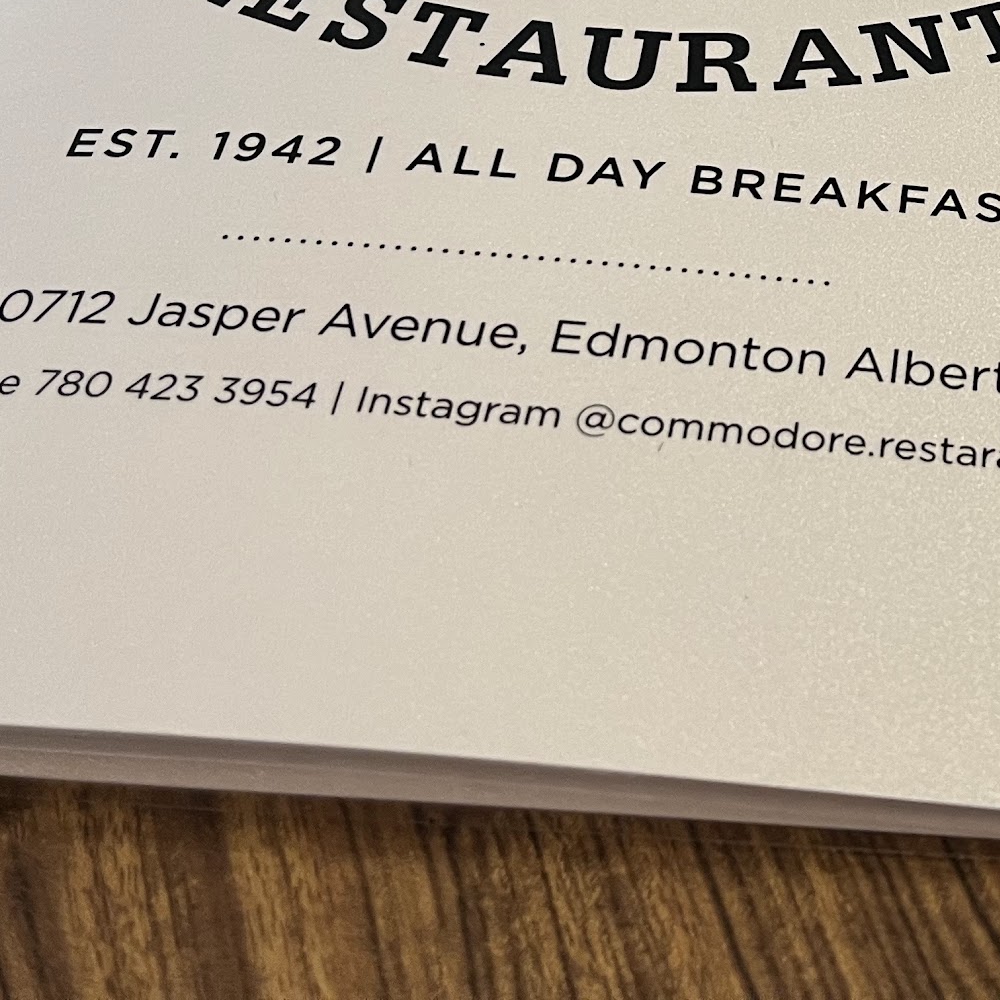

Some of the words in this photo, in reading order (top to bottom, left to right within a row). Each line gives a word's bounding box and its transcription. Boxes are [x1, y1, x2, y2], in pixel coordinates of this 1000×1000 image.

[66, 128, 181, 160] EST.
[212, 131, 342, 166] 1942
[404, 142, 518, 179] ALL
[546, 152, 667, 190] DAY
[127, 292, 306, 337] Jasper
[317, 303, 529, 357] Avenue,
[550, 319, 826, 377] Edmonton
[34, 369, 113, 398] 780
[124, 372, 205, 402] 423
[213, 376, 317, 409] 3954
[356, 386, 562, 428] Instagram
